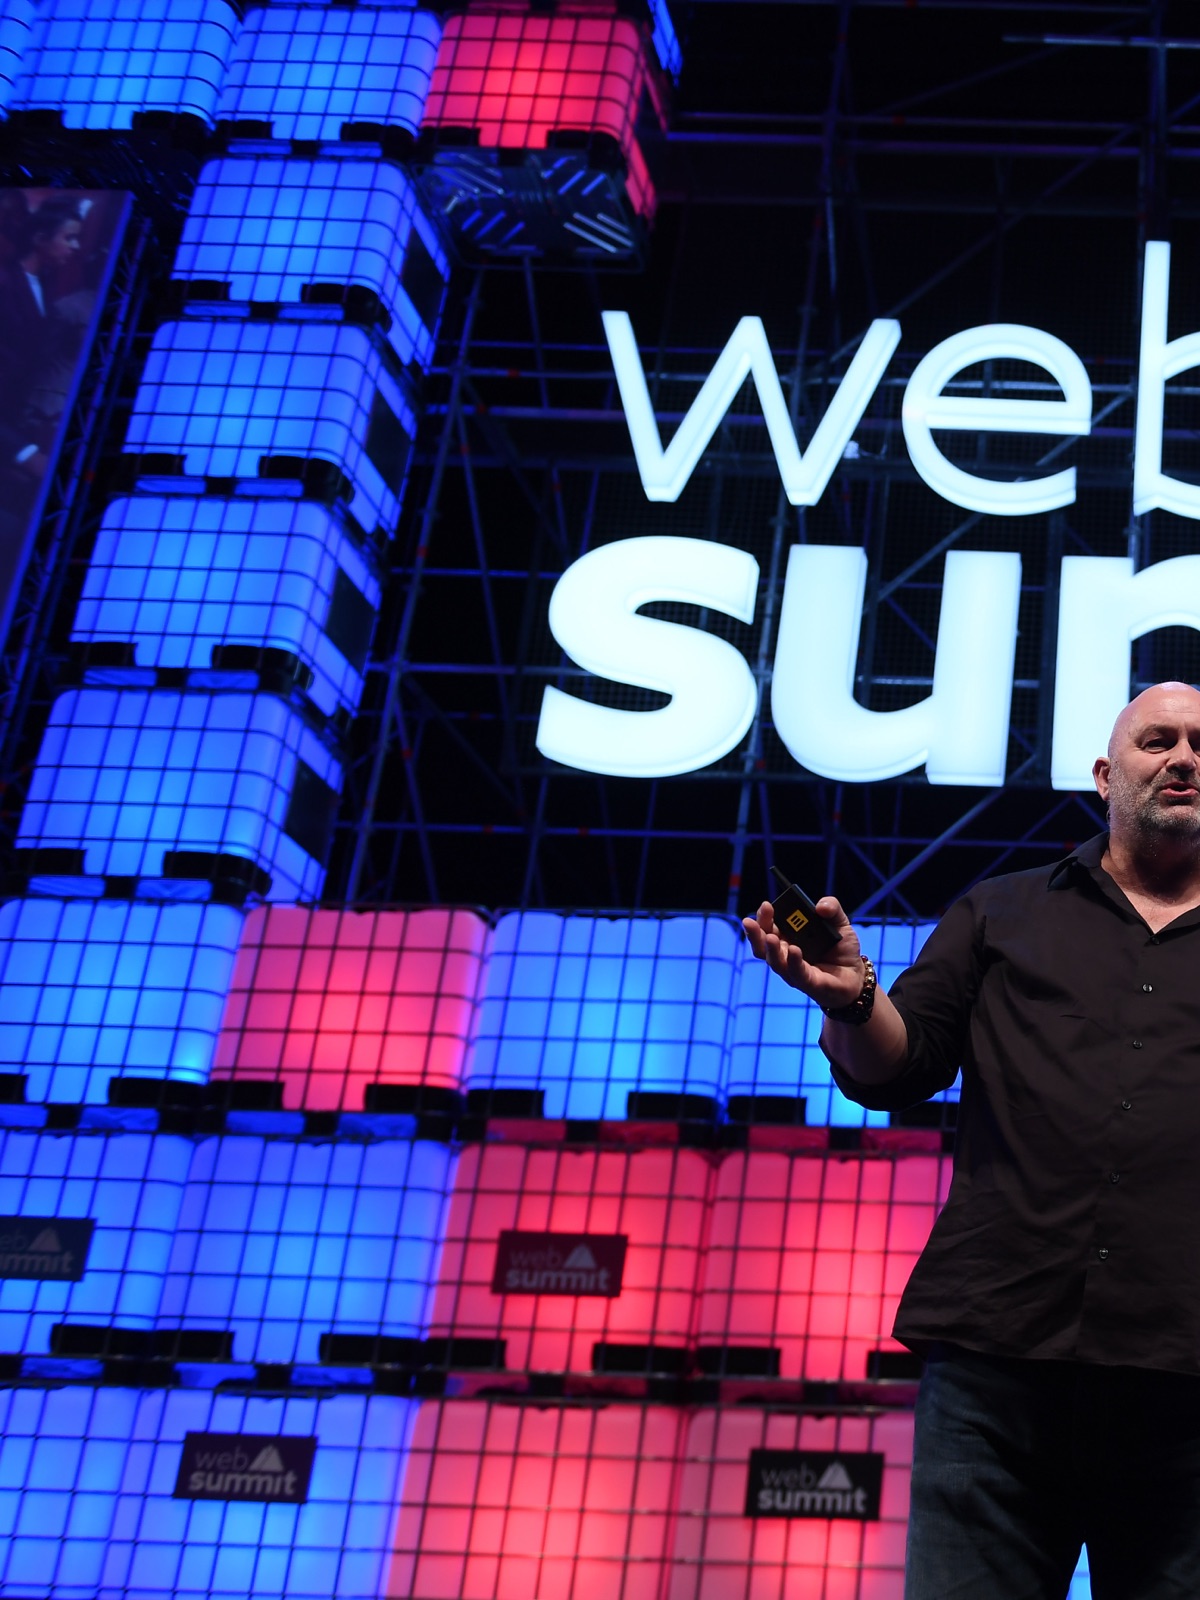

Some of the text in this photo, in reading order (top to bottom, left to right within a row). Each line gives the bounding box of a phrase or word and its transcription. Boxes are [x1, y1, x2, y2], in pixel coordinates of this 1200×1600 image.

[509, 1244, 562, 1269] web
[505, 1267, 610, 1292] summit
[195, 1445, 248, 1471] web
[188, 1469, 298, 1496] summit
[761, 1462, 817, 1489] web
[757, 1487, 867, 1514] summit
